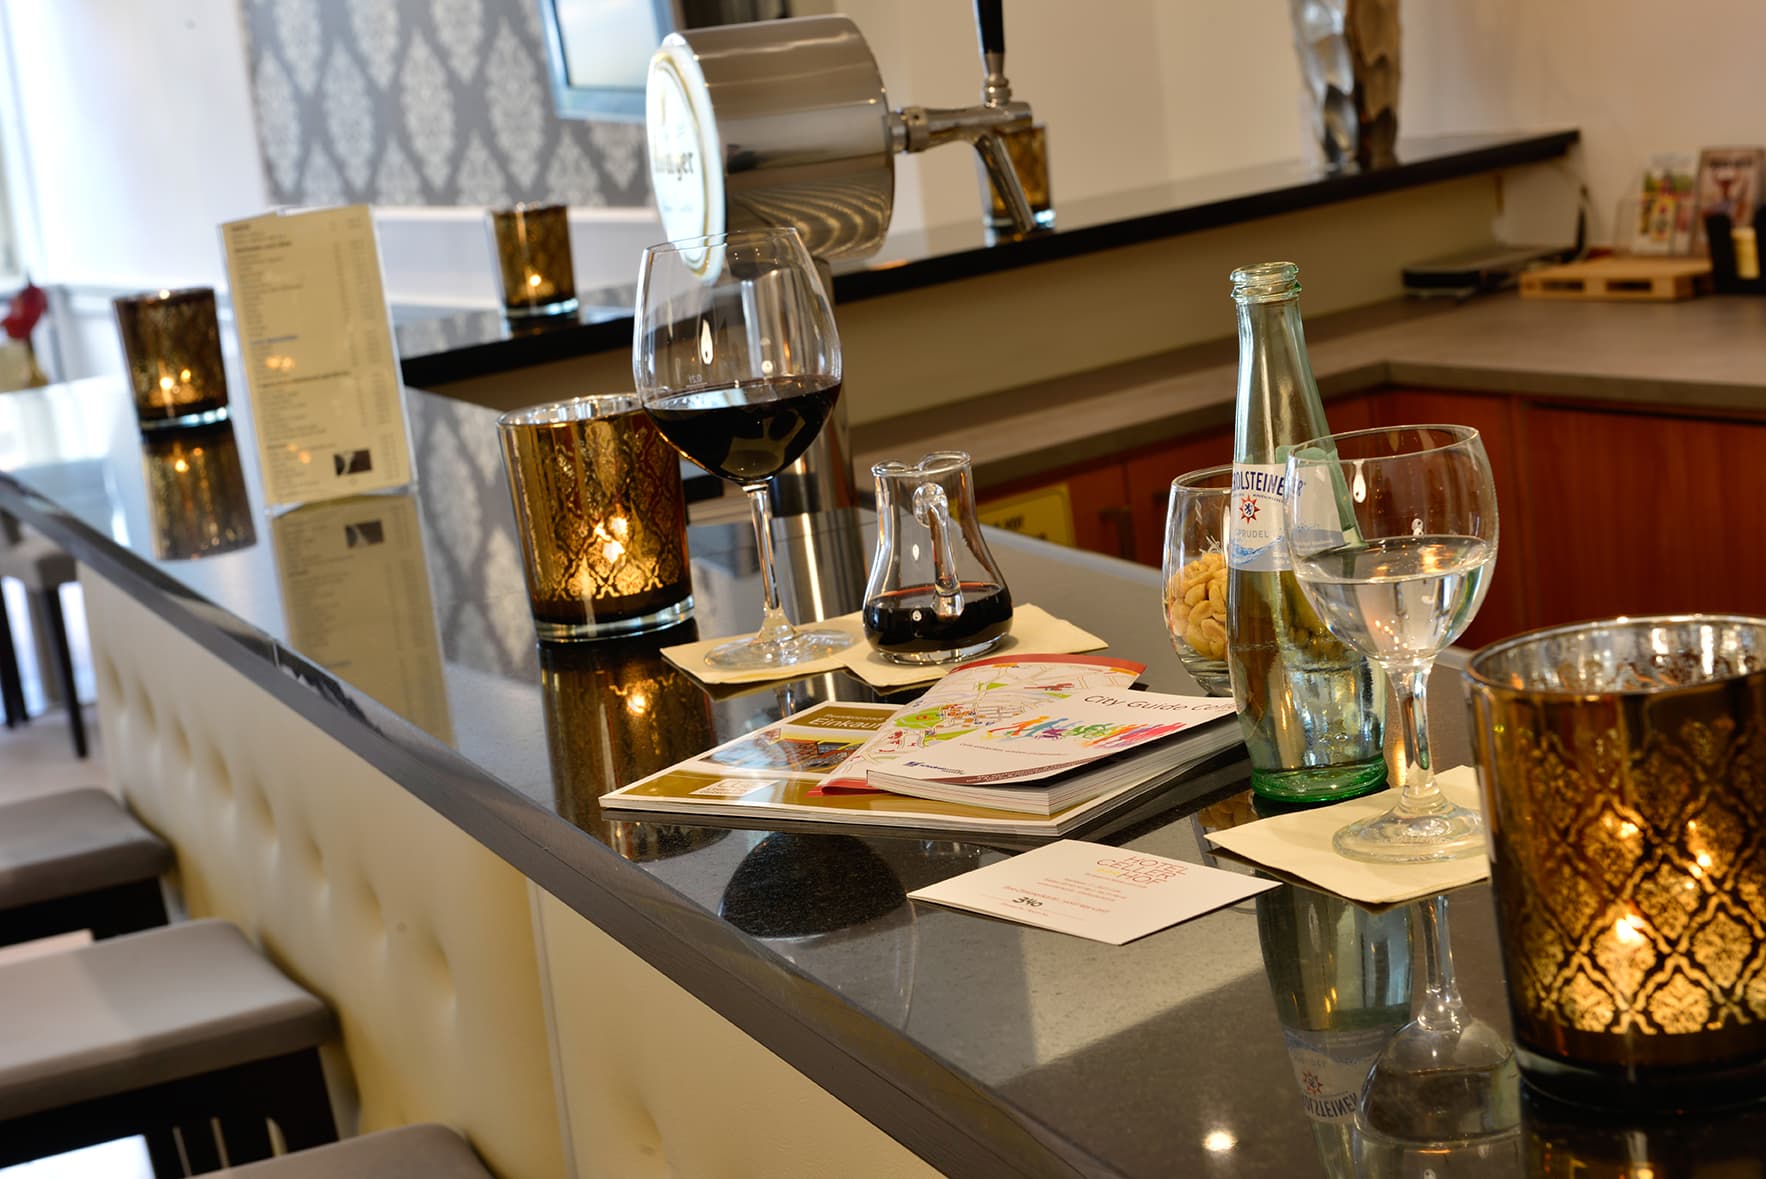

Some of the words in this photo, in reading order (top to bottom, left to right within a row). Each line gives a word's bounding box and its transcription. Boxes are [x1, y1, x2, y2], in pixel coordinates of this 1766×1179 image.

[1084, 695, 1121, 707] City
[1127, 700, 1188, 711] Guide
[1123, 856, 1188, 875] HOTEL
[1117, 872, 1168, 885] HOF
